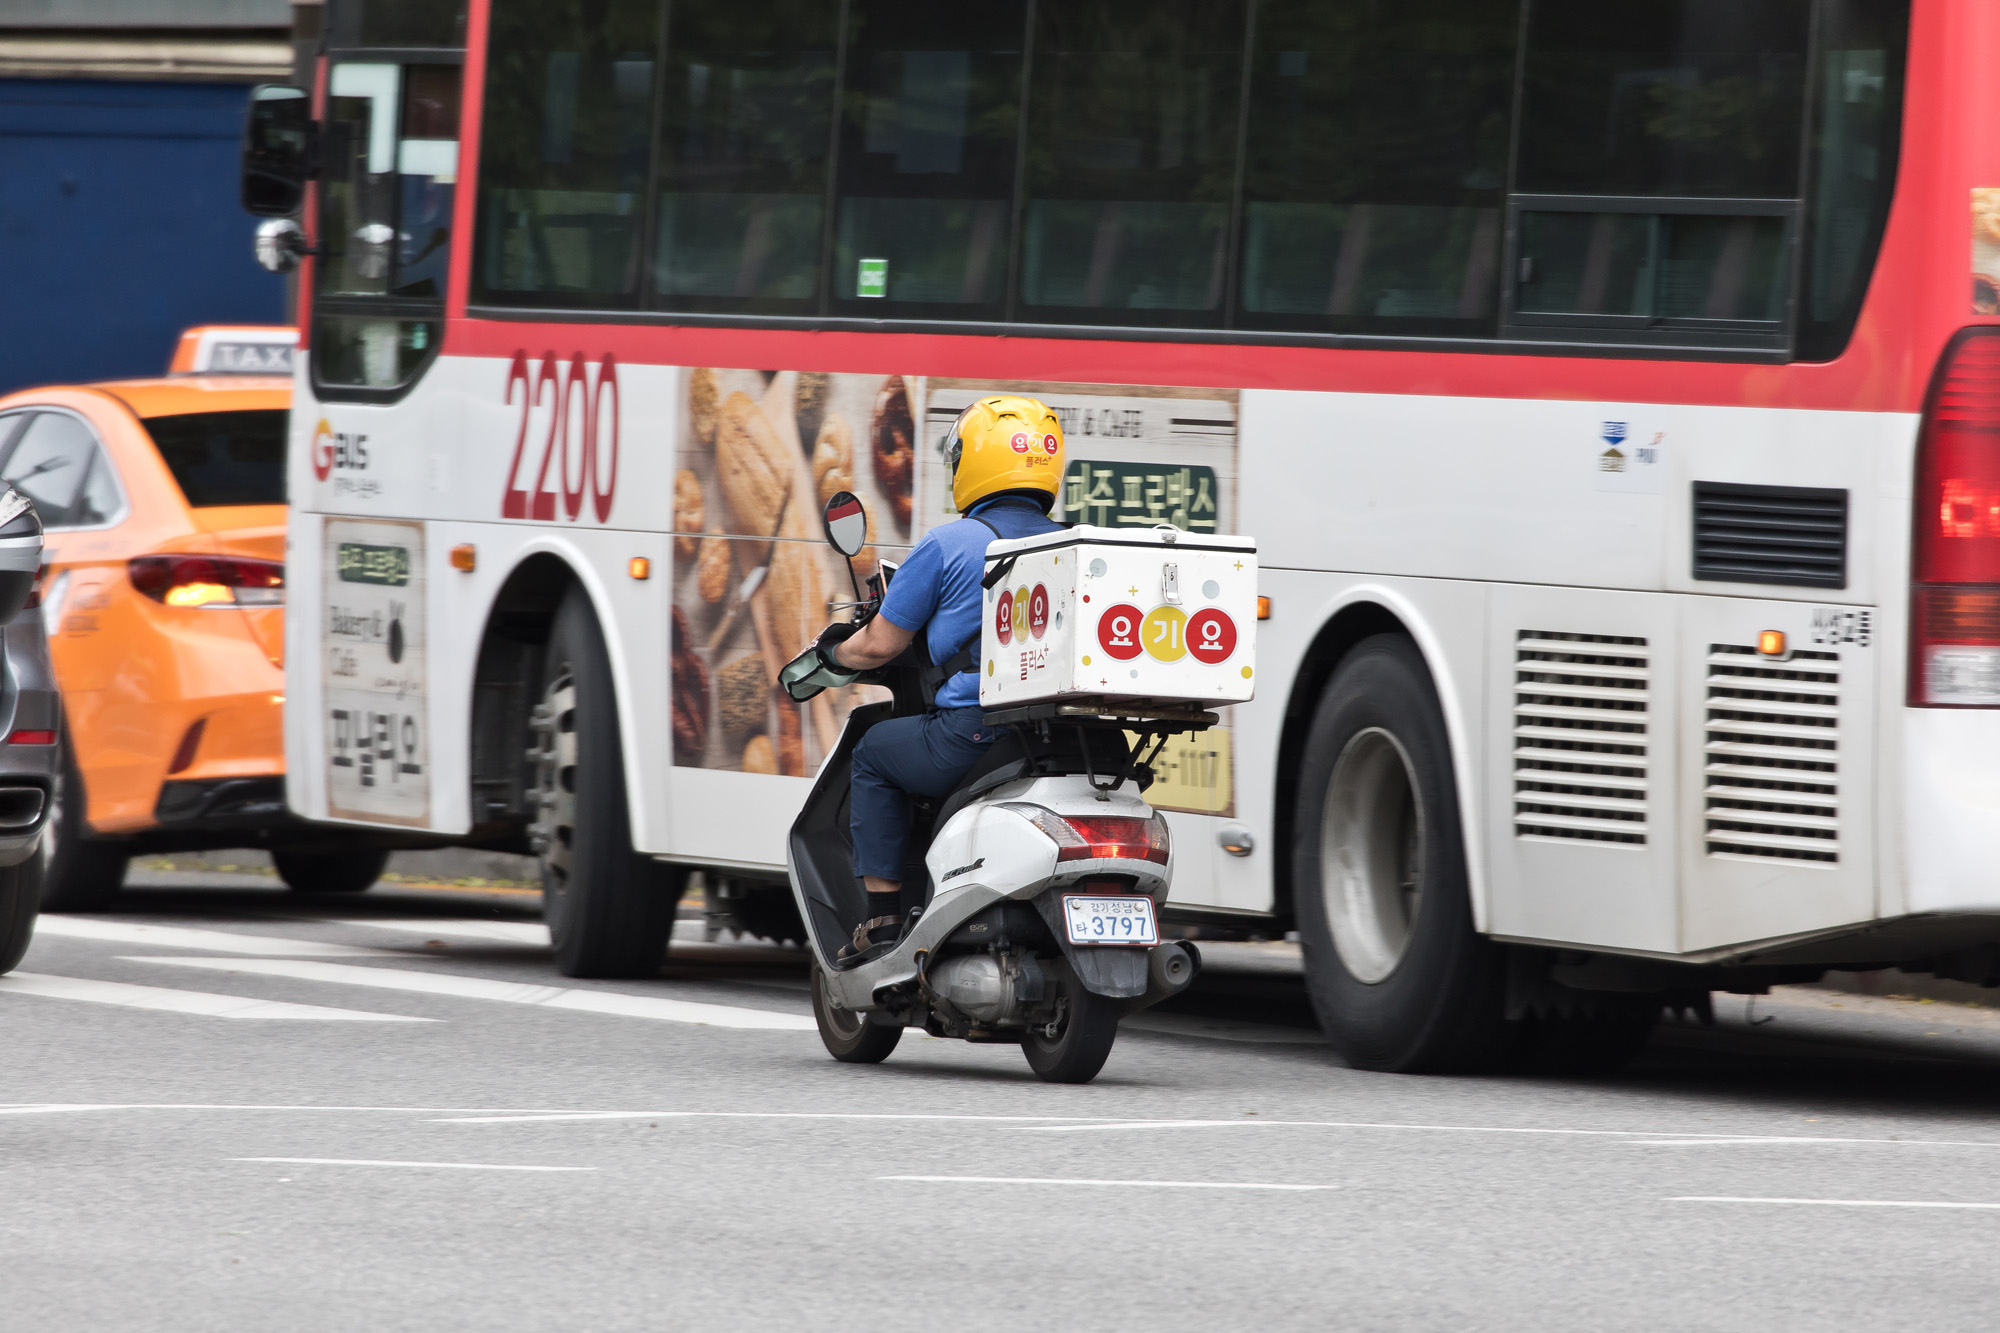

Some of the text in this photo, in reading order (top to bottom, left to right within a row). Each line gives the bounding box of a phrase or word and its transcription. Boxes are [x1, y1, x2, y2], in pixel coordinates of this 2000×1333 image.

[501, 349, 619, 525] 2200
[1013, 435, 1056, 451] 요기요
[999, 593, 1045, 635] 요기요
[1106, 613, 1226, 653] 요기요
[1076, 916, 1146, 937] 타 3797
